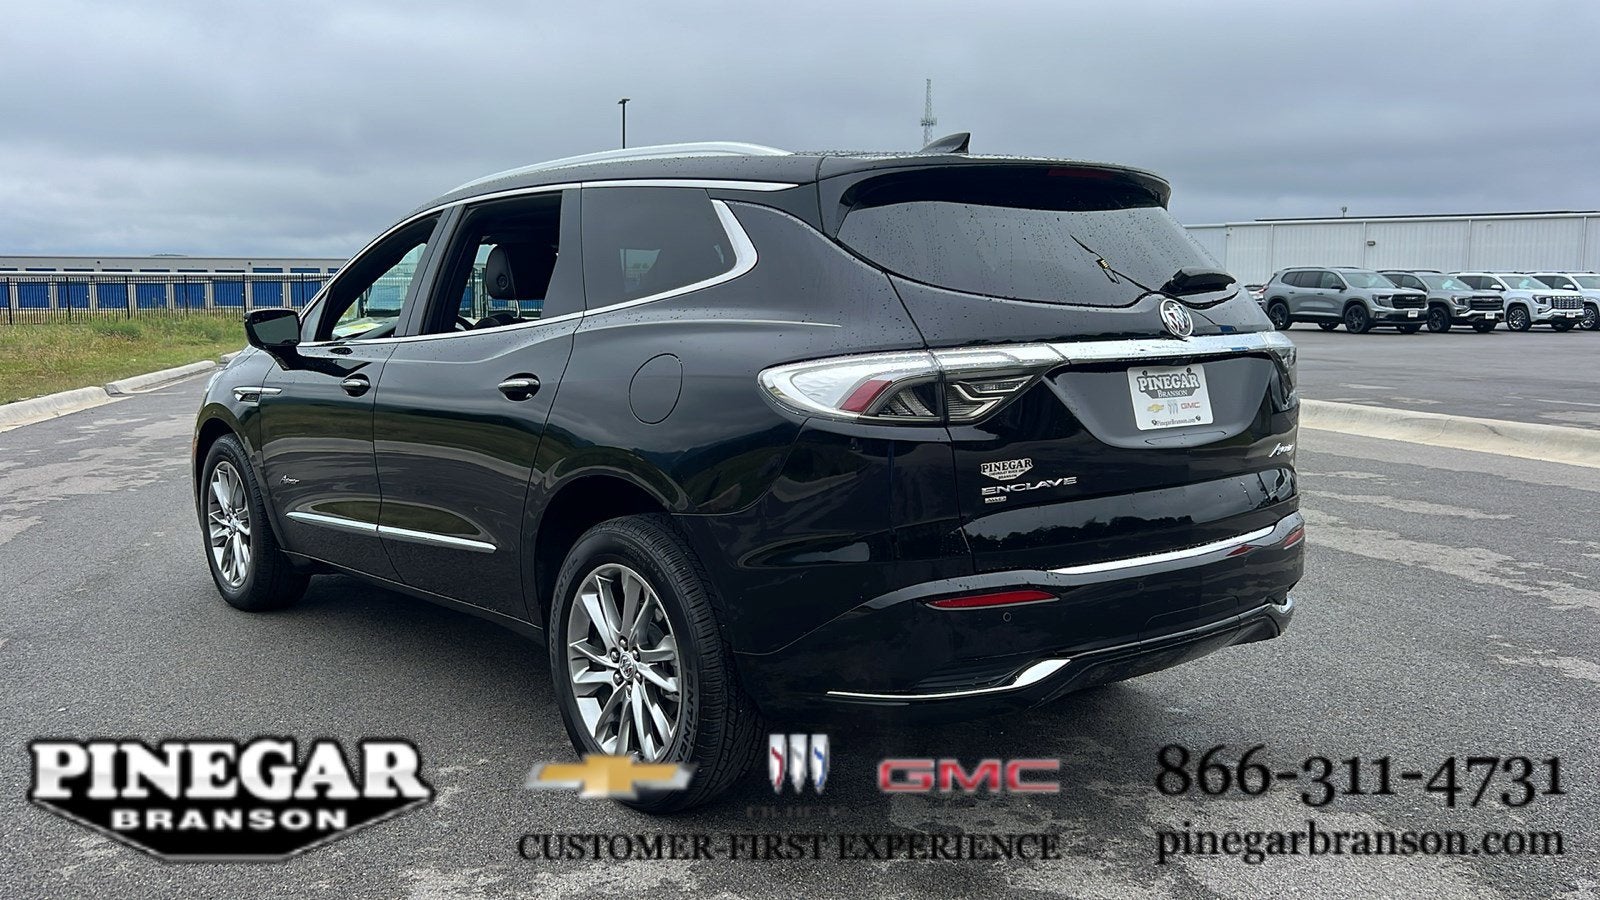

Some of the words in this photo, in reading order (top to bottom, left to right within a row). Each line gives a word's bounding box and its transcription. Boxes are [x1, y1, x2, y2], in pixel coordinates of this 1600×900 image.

[1137, 373, 1200, 392] PINEGAR
[1180, 402, 1201, 410] GMC
[981, 459, 1032, 473] PINEGAR
[981, 476, 1078, 496] ENCLAVE
